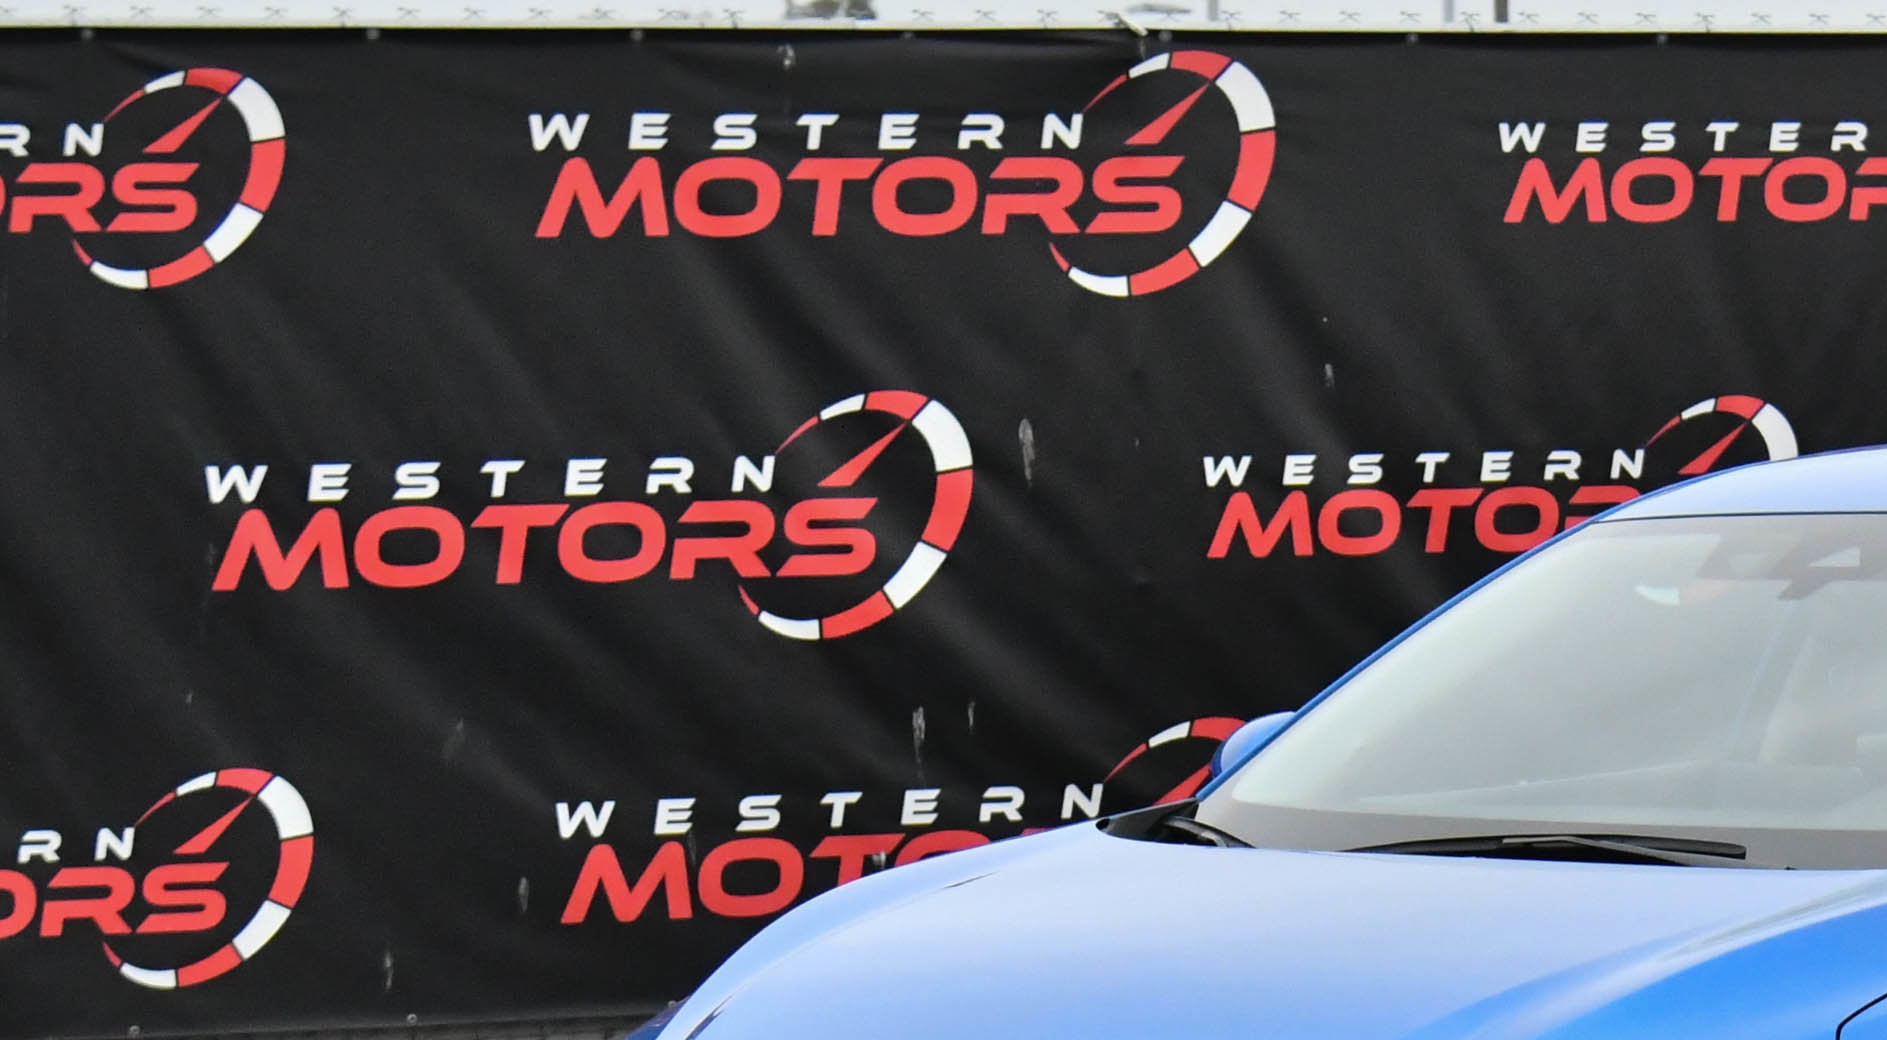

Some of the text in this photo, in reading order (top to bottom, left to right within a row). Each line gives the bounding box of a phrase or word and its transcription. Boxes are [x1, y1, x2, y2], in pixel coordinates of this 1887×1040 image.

[528, 113, 1084, 151] WESTERN
[0, 162, 200, 233] RS
[535, 155, 1185, 239] MOTORS
[205, 455, 776, 504] WESTERN
[1203, 448, 1645, 487] WESTERN
[212, 497, 878, 592] MOTORS
[555, 783, 1104, 839] WESTERN
[561, 827, 1051, 924] MOT
